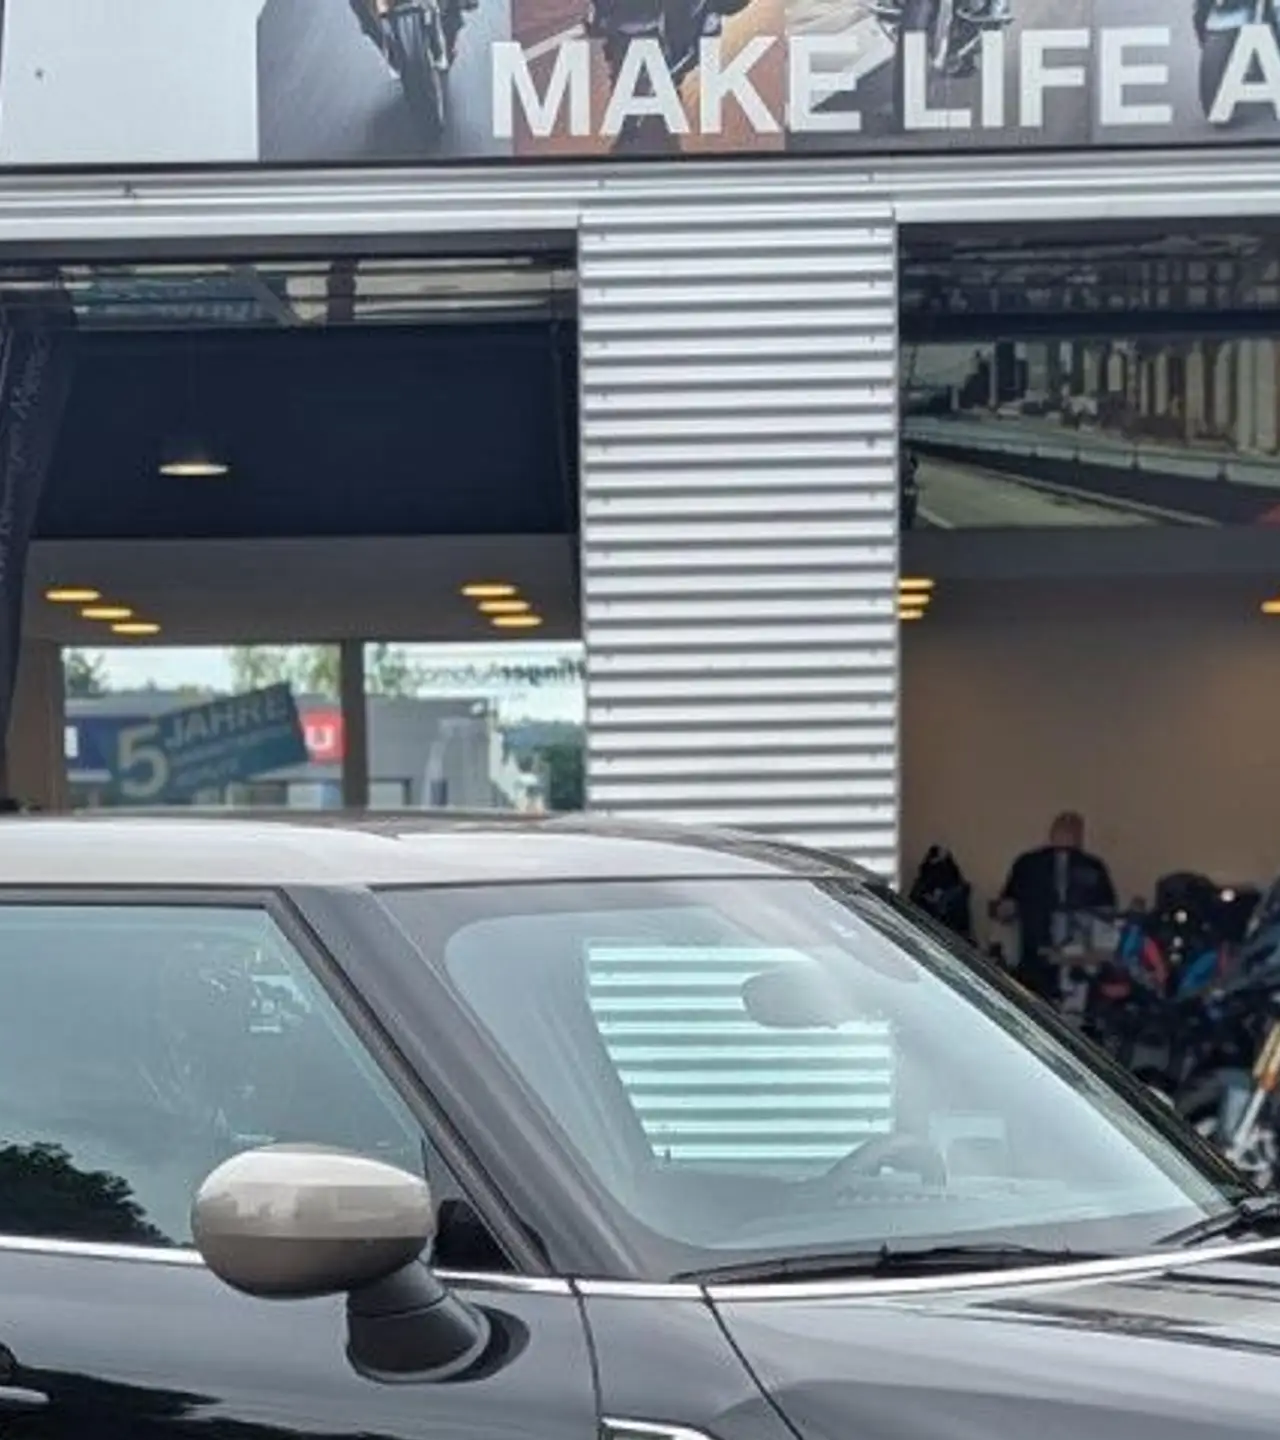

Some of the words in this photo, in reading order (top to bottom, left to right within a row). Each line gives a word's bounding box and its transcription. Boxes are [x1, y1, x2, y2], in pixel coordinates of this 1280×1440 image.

[491, 34, 862, 138] MAKE
[903, 26, 1173, 129] LIFE
[117, 722, 170, 798] 5
[164, 687, 289, 748] JAHRE
